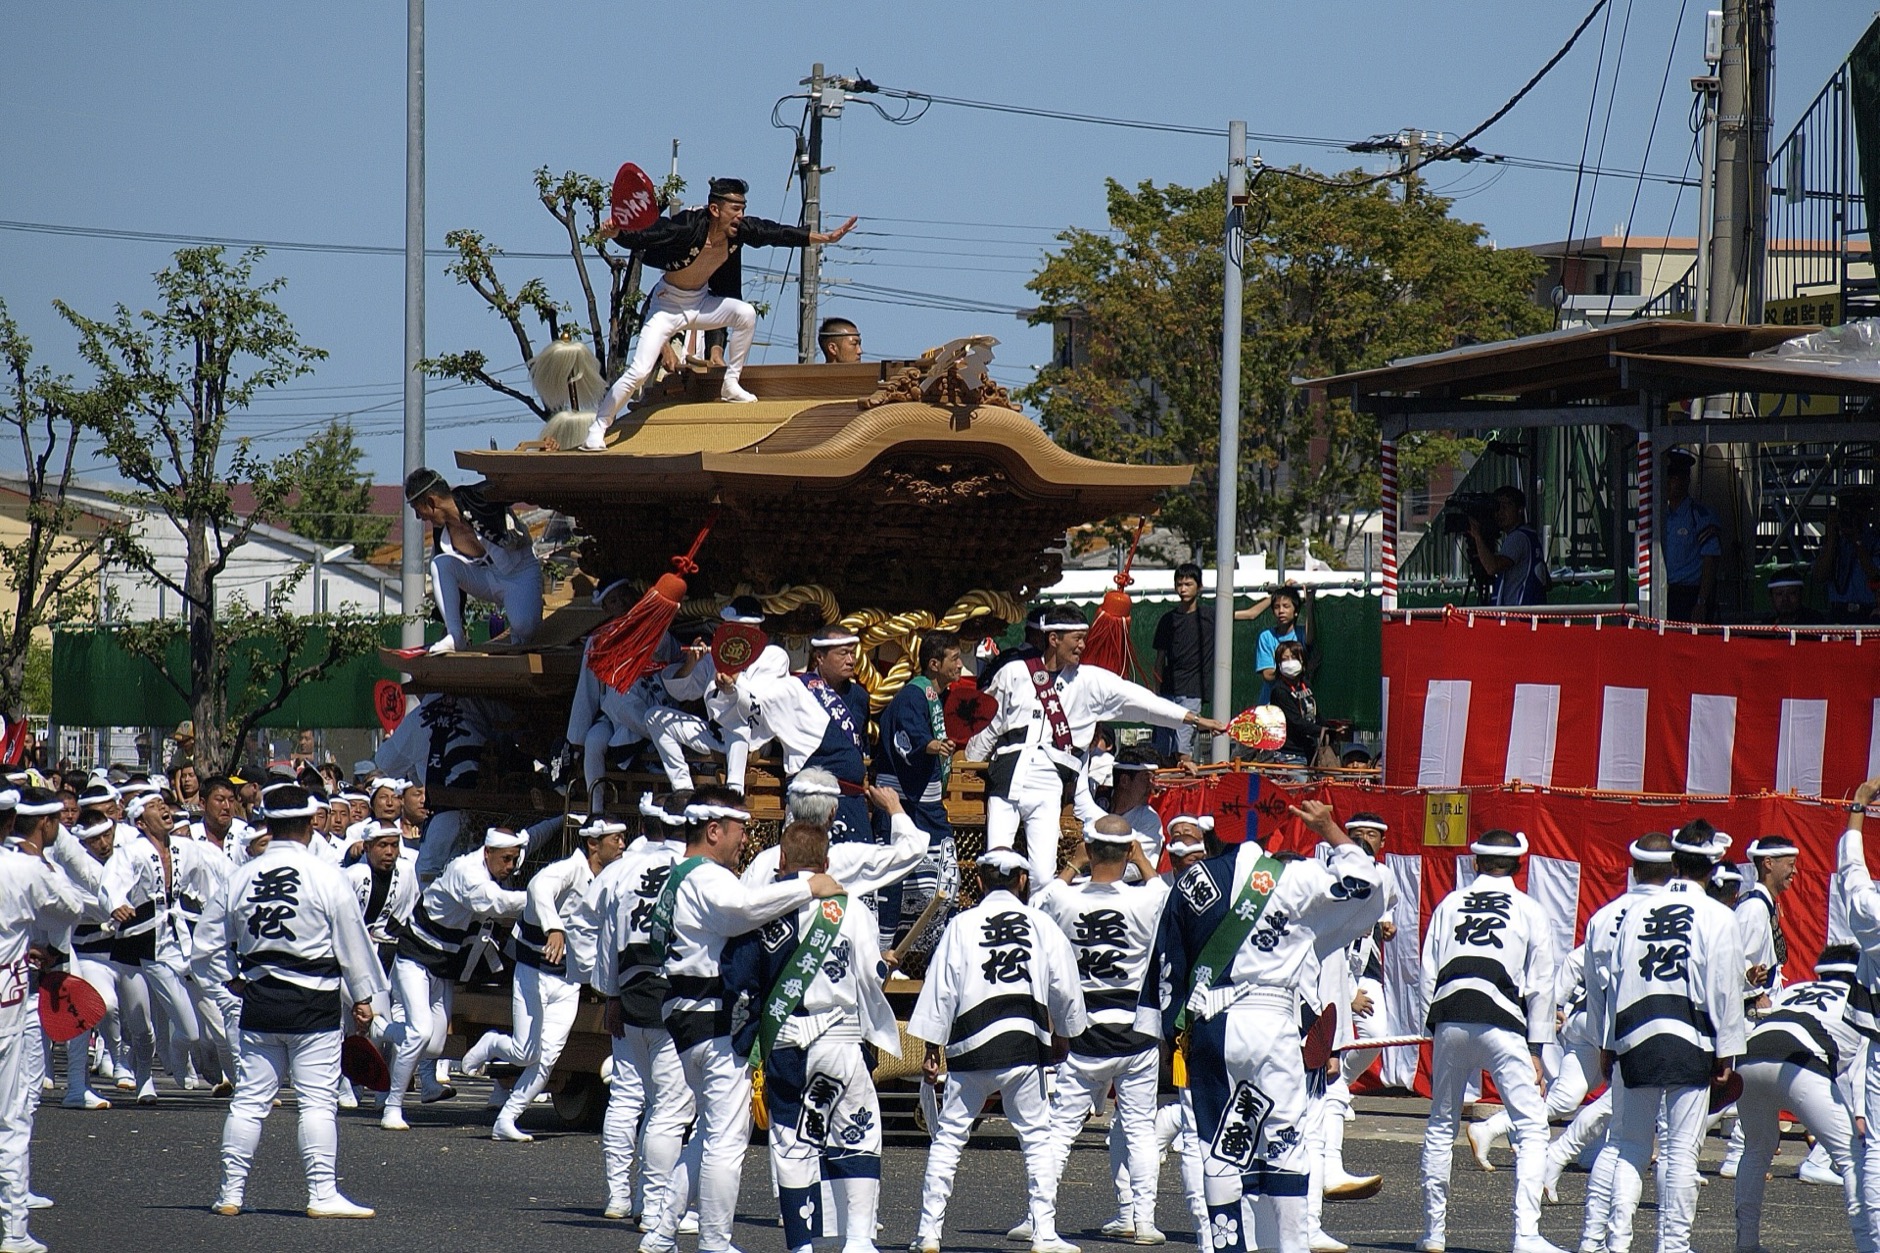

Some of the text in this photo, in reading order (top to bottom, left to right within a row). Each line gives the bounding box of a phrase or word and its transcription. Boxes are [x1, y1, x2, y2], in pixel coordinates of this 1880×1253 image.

[1431, 802, 1464, 816] 立入禁止
[247, 866, 301, 941] 並松
[1454, 890, 1512, 949] 並松
[769, 928, 832, 1023] 副年番長
[978, 911, 1033, 984] 並松
[1071, 909, 1130, 980] 並松
[1637, 904, 1695, 983] 並松
